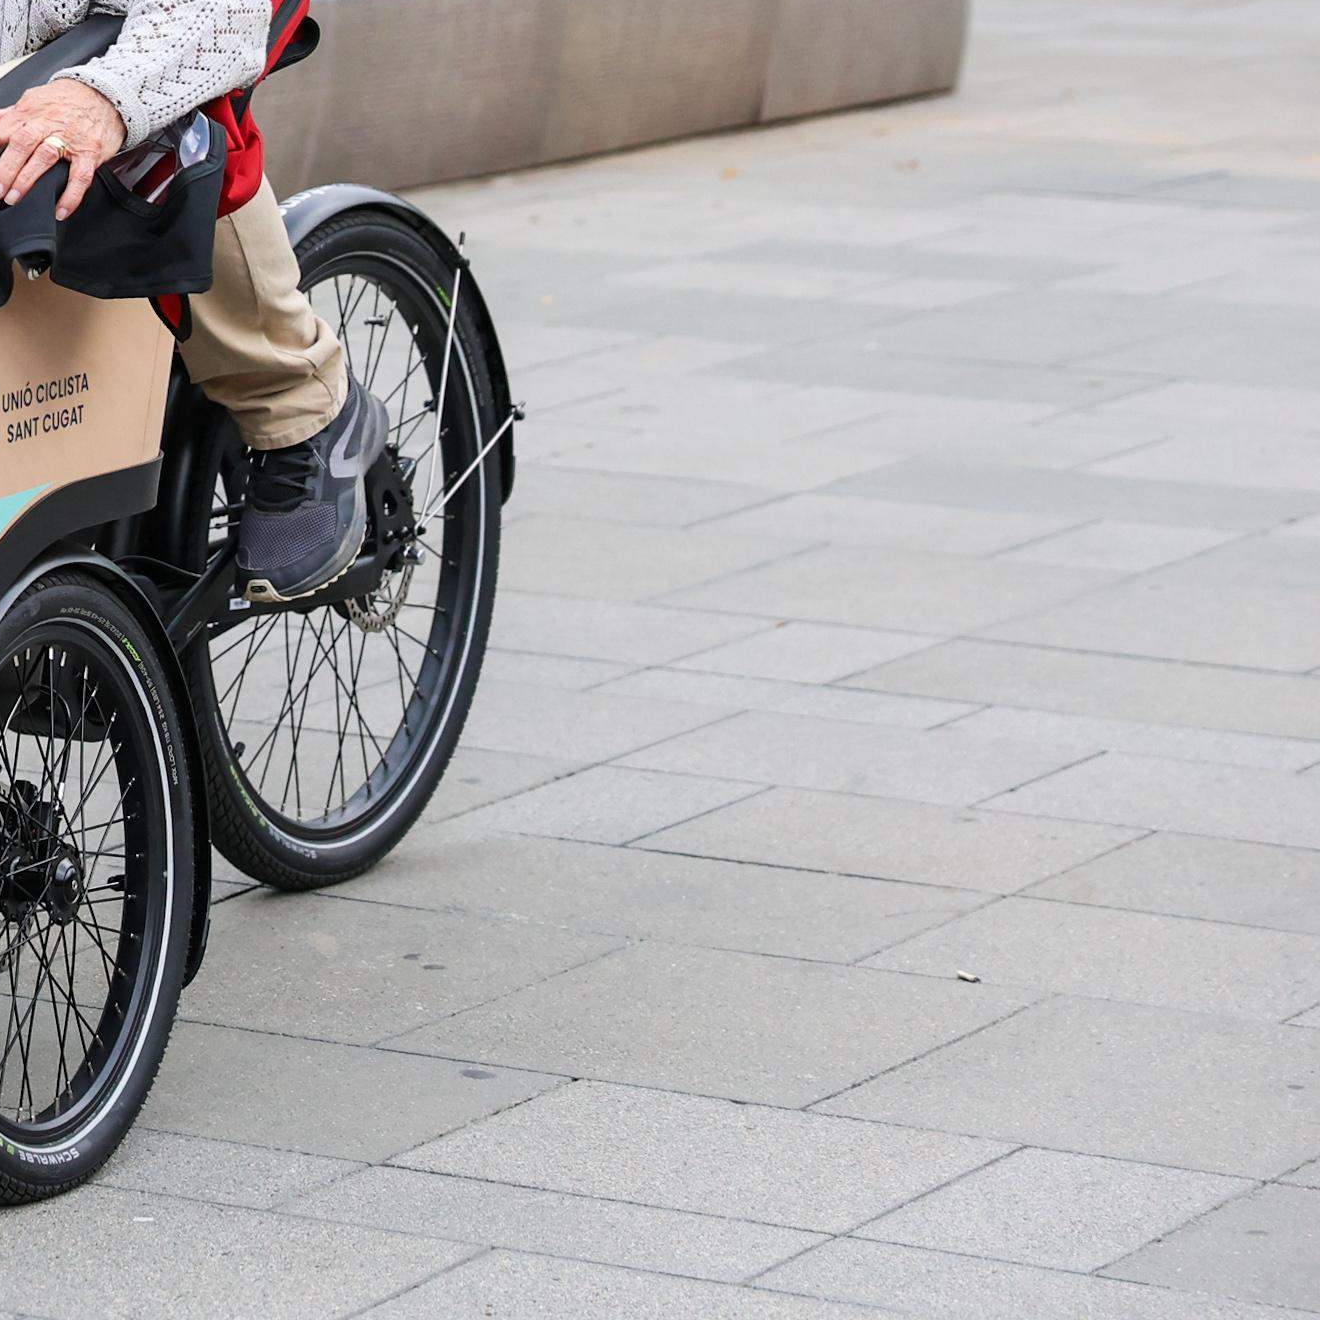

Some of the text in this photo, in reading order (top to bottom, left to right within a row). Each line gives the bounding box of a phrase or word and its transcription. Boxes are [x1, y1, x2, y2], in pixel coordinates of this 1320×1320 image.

[1, 372, 89, 413] UNIÓ CICLISTA
[7, 404, 84, 443] SANT CUGAT
[18, 1147, 80, 1165] SCHWALBE
